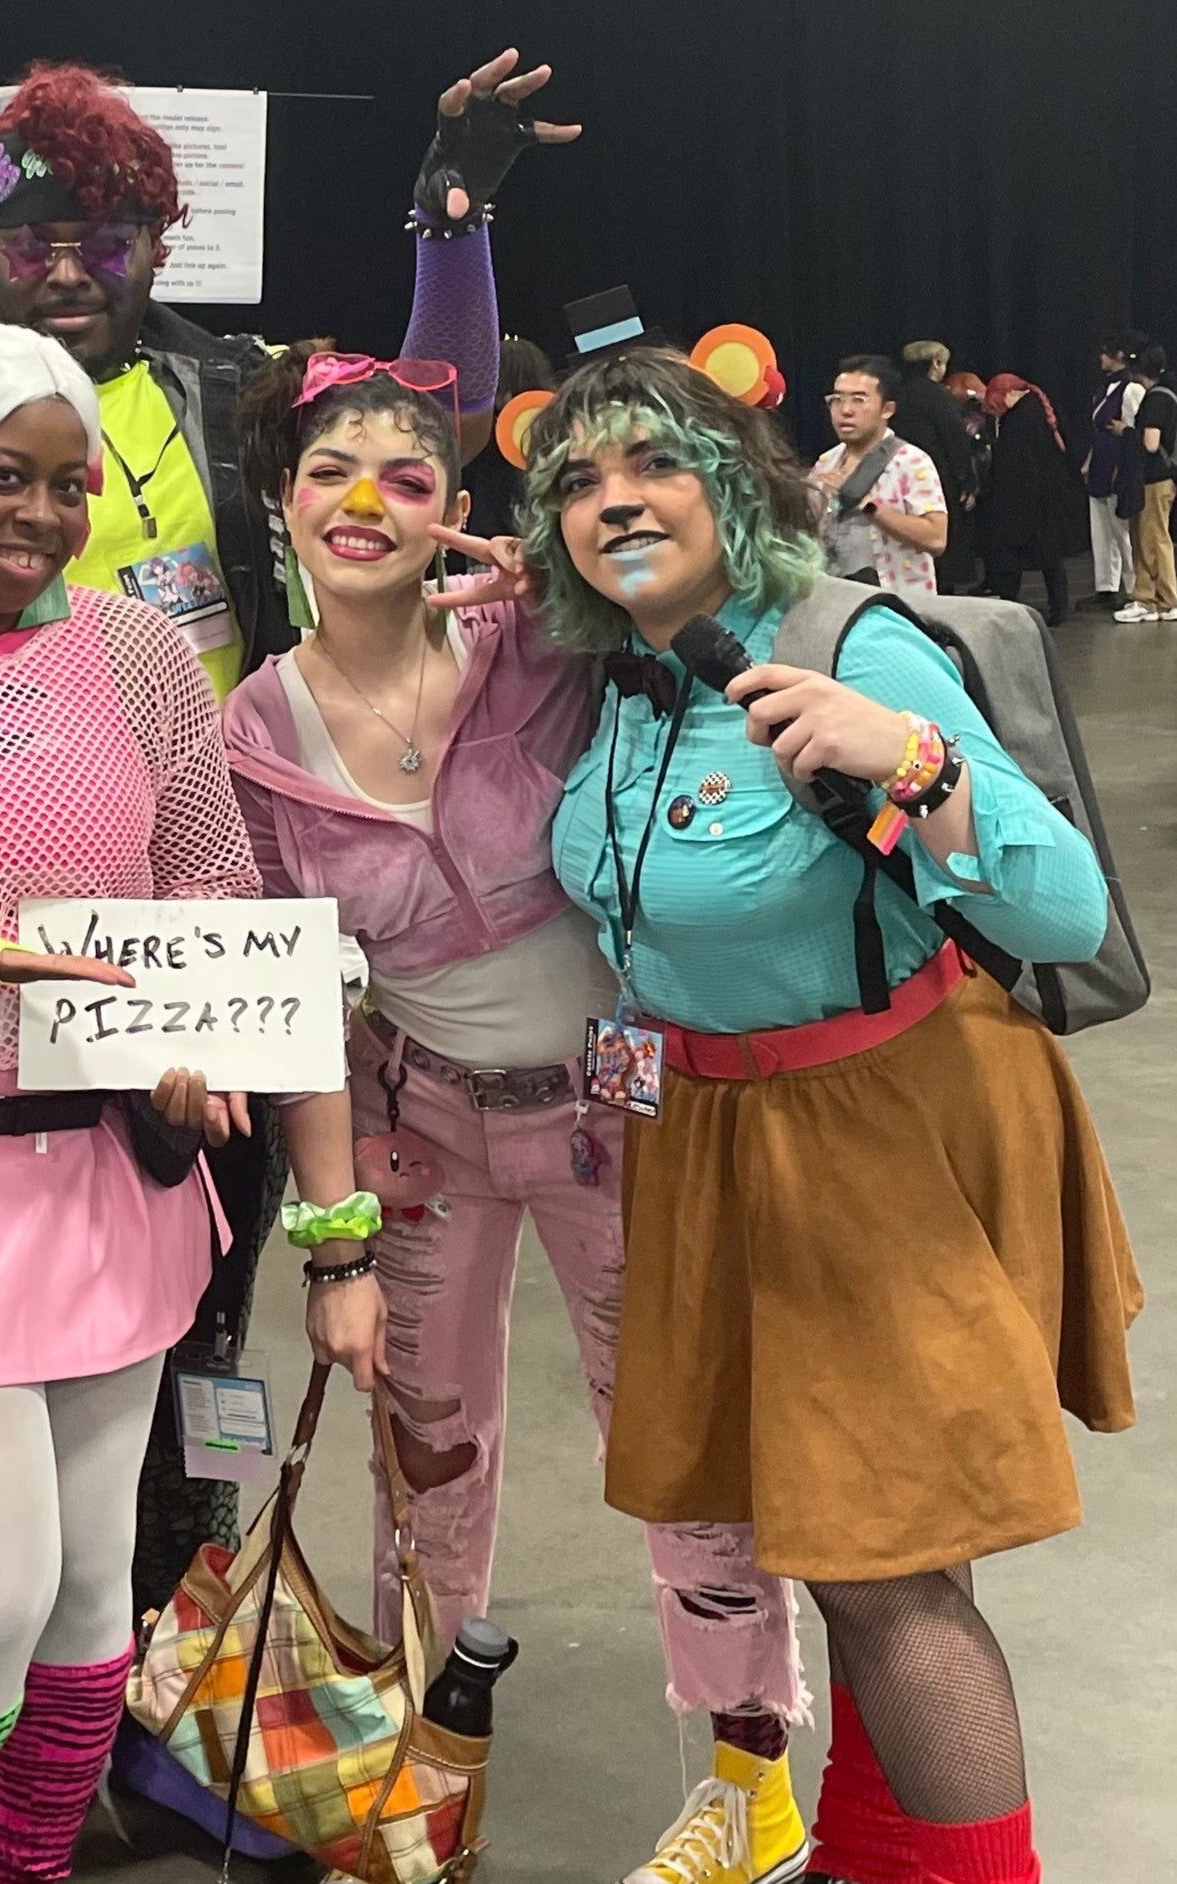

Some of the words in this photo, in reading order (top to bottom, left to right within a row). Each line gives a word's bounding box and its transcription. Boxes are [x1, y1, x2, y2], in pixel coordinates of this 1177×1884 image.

[37, 909, 225, 969] WHERE'S
[243, 925, 301, 958] MY
[49, 995, 301, 1044] PIZZA???
